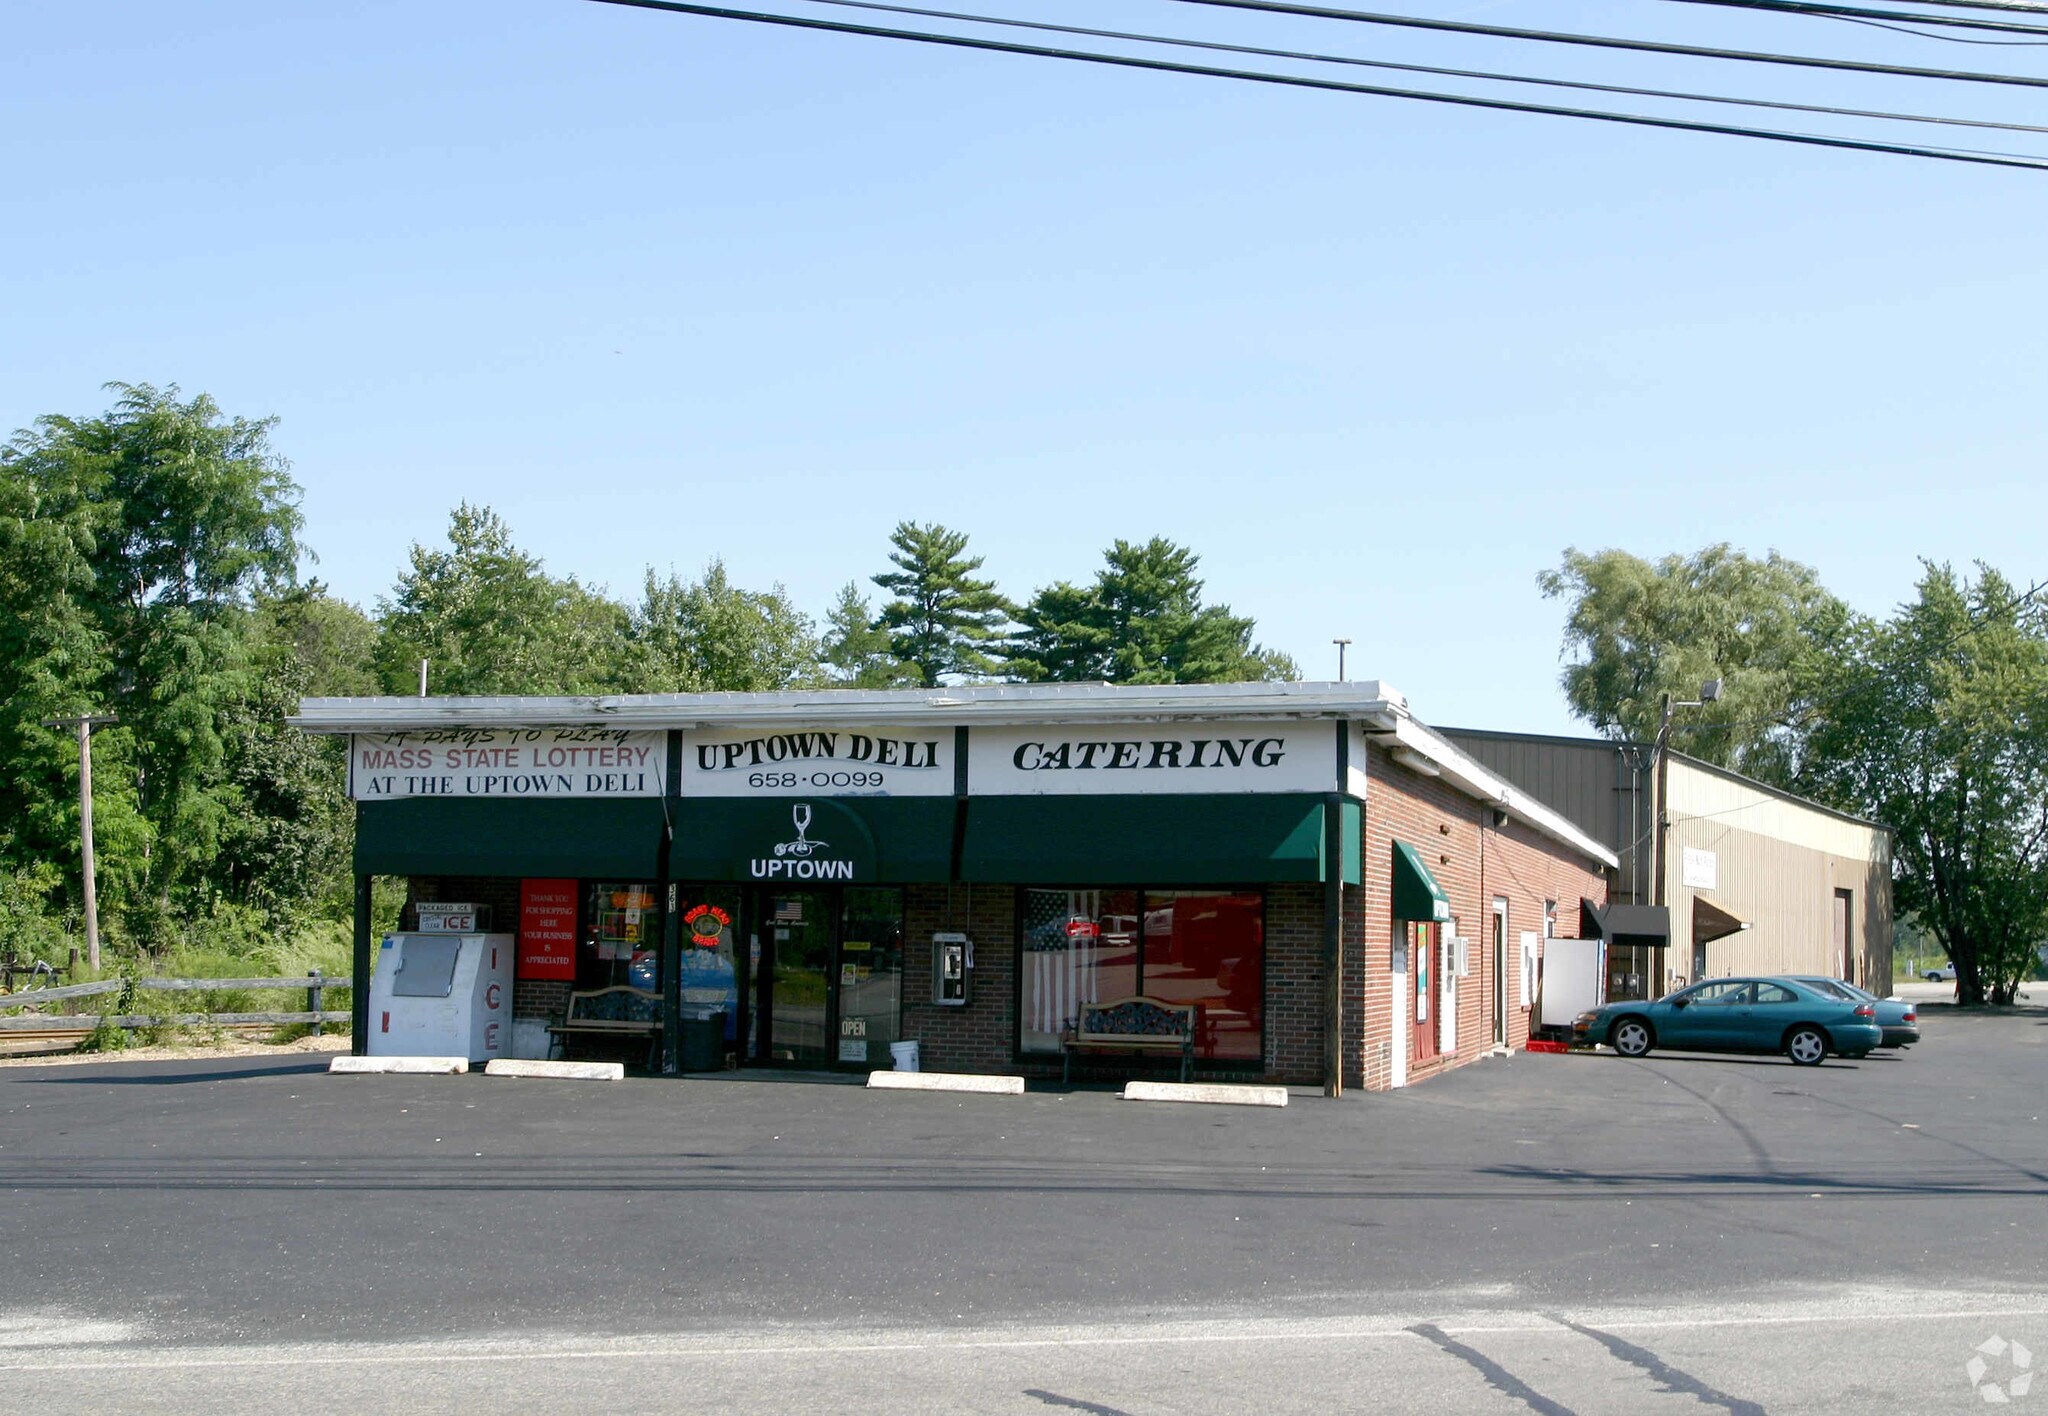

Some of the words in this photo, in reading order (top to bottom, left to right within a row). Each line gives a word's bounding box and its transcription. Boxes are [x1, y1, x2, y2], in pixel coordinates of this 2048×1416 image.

[385, 730, 405, 747] IT
[423, 729, 495, 748] PAYS
[512, 729, 542, 745] TO
[553, 729, 631, 747] PLAY
[362, 748, 432, 769] MASS
[446, 748, 519, 769] STATE
[533, 747, 650, 768] LOTTERY
[696, 732, 840, 770] UPTOWN
[847, 733, 939, 768] DELI
[1012, 738, 1286, 771] CATERING
[366, 776, 396, 794] AT
[404, 776, 454, 794] THE
[465, 774, 573, 794] UPTOWN
[585, 773, 646, 792] DELI
[751, 859, 854, 880] UPTOWN
[529, 894, 553, 902] THANK
[526, 906, 539, 914] FOR
[540, 906, 573, 915] SHOPPING
[443, 916, 471, 929] ICE
[539, 919, 557, 927] HERE
[524, 931, 542, 939] YOUR
[543, 931, 573, 940] BUSINESS
[526, 956, 569, 965] APPRECIATED
[485, 948, 500, 1050] ICE
[842, 1020, 866, 1036] OPEN
